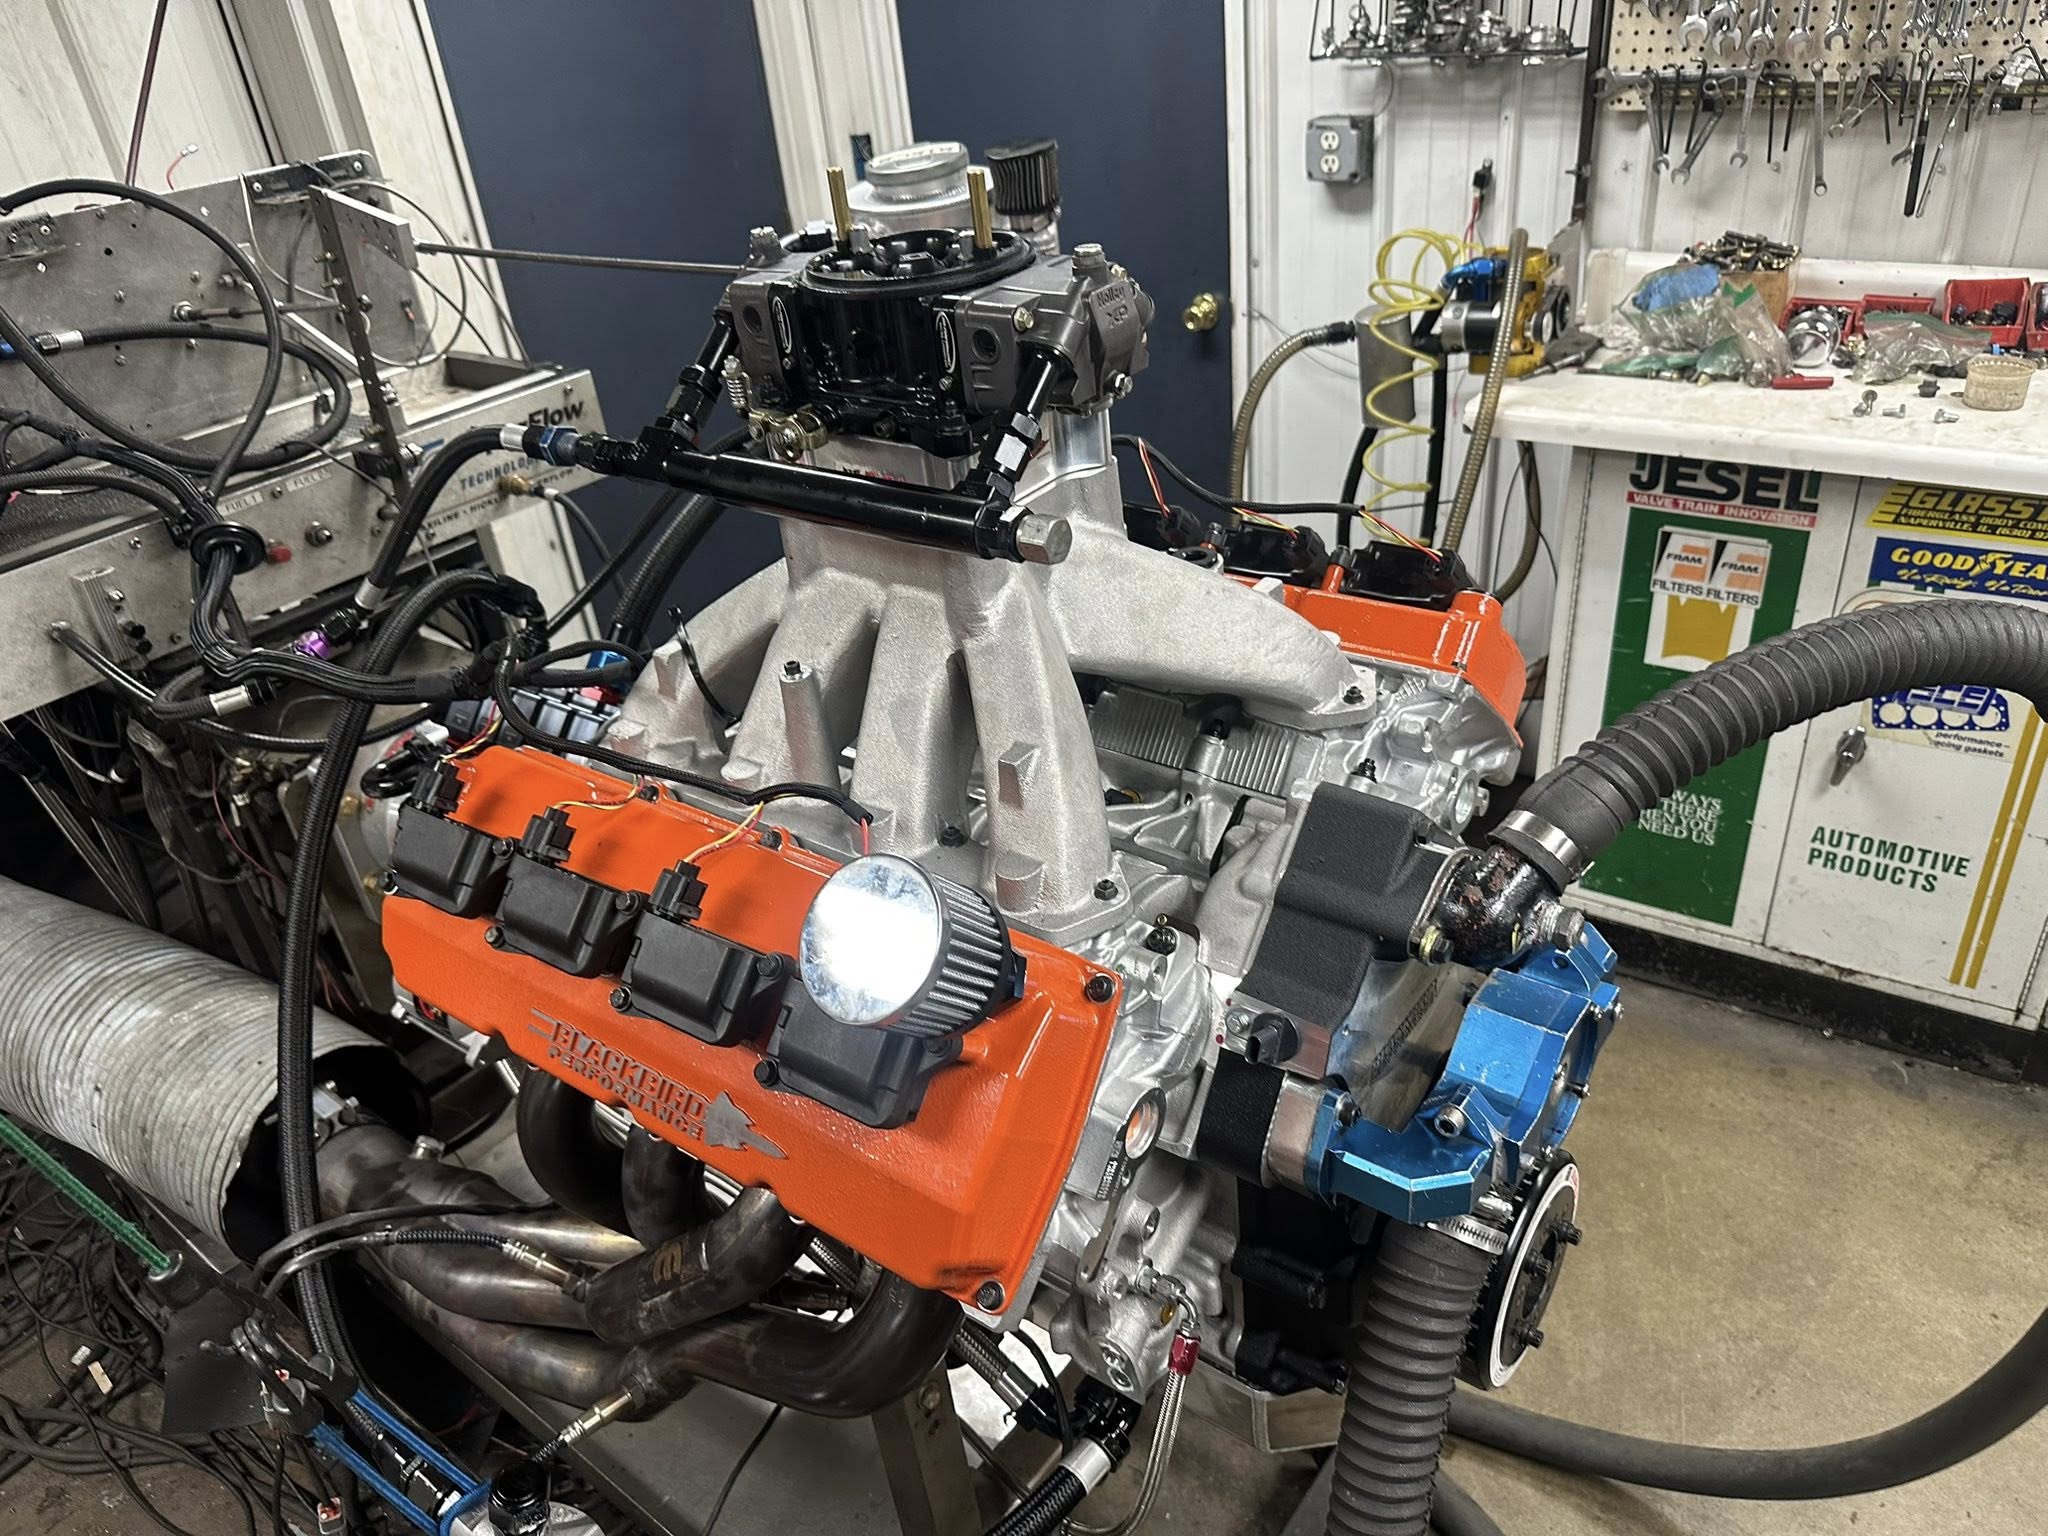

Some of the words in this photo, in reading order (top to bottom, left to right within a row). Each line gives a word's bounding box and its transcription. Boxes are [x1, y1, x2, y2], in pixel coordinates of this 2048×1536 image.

[1629, 453, 1821, 513] JESEL
[1633, 492, 1674, 505] VALVE
[1677, 500, 1720, 514] TRAIN
[1723, 506, 1811, 526] INNOVATION
[1900, 508, 1976, 523] FIBERGLASS
[1980, 516, 2018, 528] BODY
[1666, 552, 1703, 565] FRAM
[1720, 561, 1760, 575] FRAM
[1891, 547, 2048, 581] GOODYEA
[1651, 578, 1704, 597] FILTERS
[1706, 587, 1760, 606] FILTERS
[1964, 745, 2005, 758] gaskets
[1661, 789, 1722, 811] WAYS
[1637, 818, 1688, 839] NEED
[1691, 831, 1715, 846] US
[1639, 808, 1677, 825] HEN
[1680, 815, 1718, 834] YOU
[1810, 825, 1971, 878] AUTOMOTIVE
[1807, 847, 1939, 893] PRODUCTS
[552, 1021, 707, 1120] BLACKBIRD
[546, 1043, 704, 1142] PERFORMANCE
